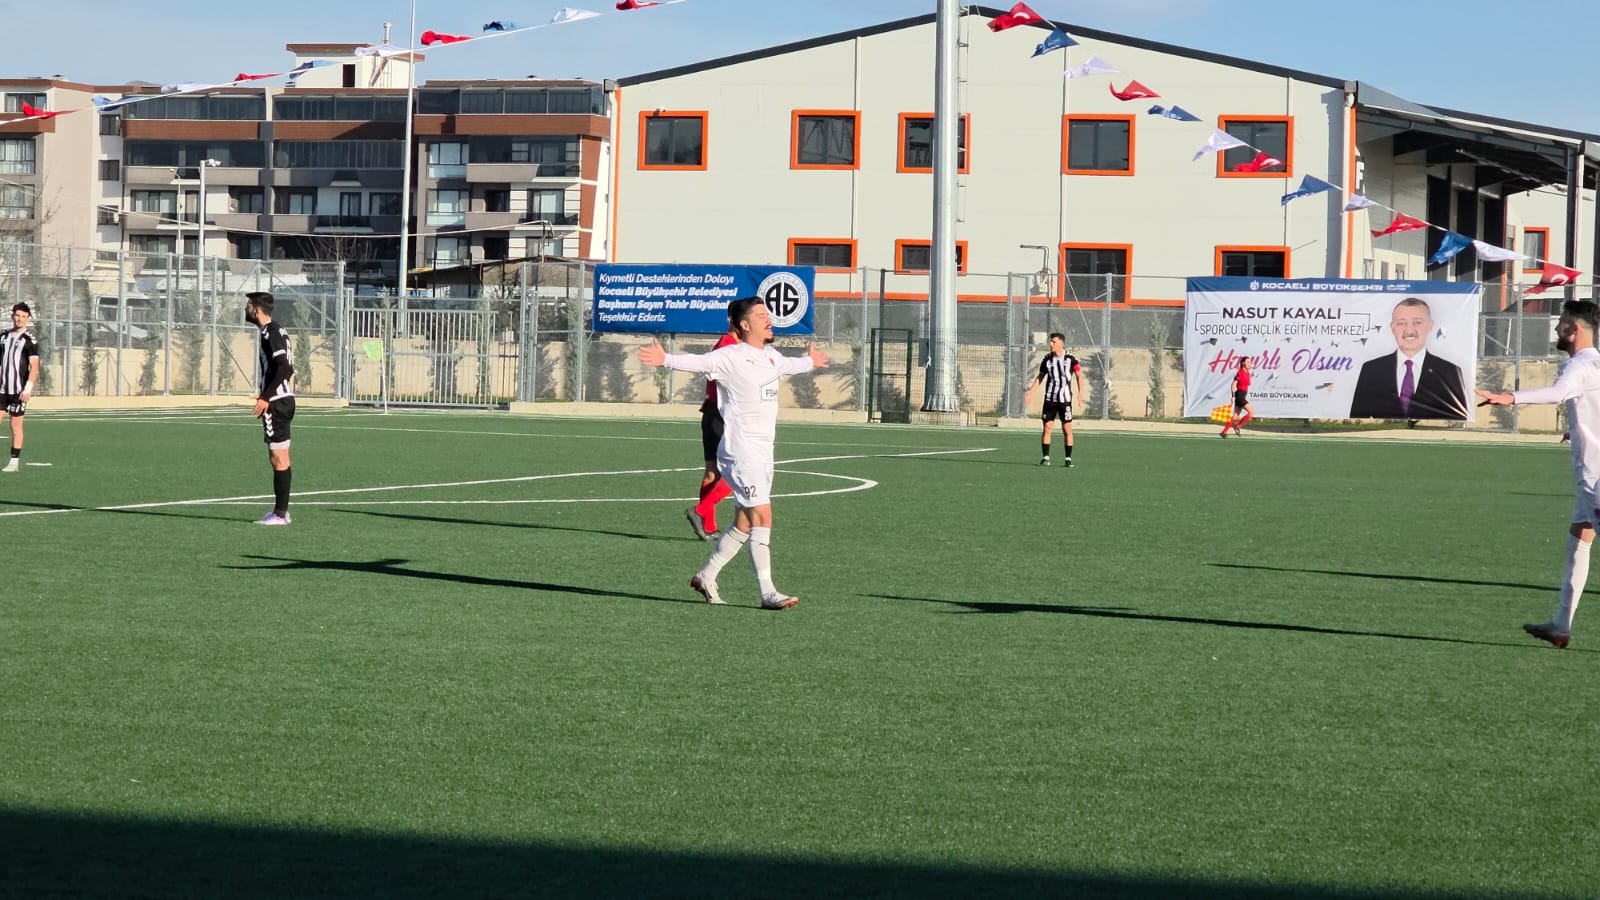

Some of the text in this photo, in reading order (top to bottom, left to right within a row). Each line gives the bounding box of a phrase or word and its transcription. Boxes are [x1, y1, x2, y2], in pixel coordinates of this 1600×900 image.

[599, 273, 734, 285] Kıymetli Desteklerinden Dolayı
[598, 286, 738, 298] Kocaeli Büyükşehir Belediyesi
[598, 299, 636, 310] Başkanı
[637, 300, 663, 311] Sayın
[665, 300, 689, 309] Tahir
[765, 282, 799, 317] AS
[598, 312, 637, 323] Teşekkür
[1222, 307, 1342, 320] NASUT KAYALI
[1200, 321, 1365, 337] SPORCU GENÇLİK EĞİTİM MERKEZİ
[1291, 347, 1353, 374] Olsun
[744, 485, 757, 499] 92
